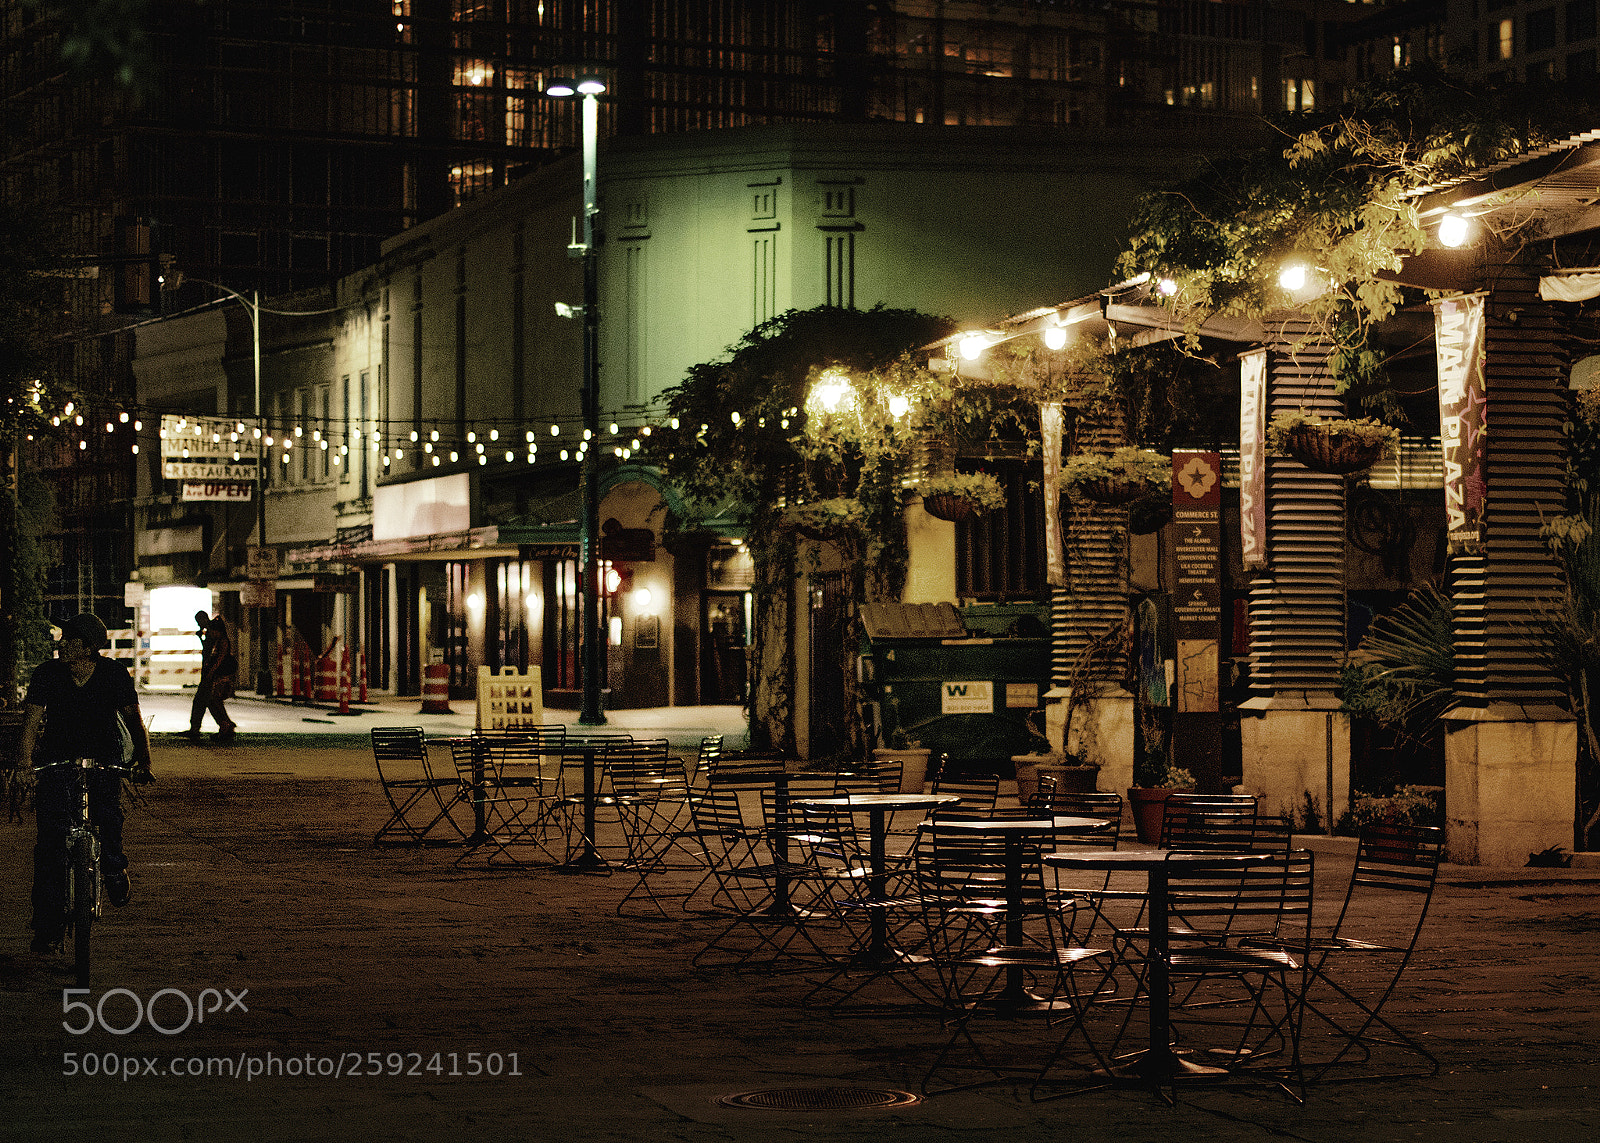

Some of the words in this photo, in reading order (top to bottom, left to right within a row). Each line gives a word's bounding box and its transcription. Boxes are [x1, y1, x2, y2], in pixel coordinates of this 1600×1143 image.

[1439, 311, 1466, 406] MAIN
[205, 482, 251, 498] OPEN
[1175, 511, 1209, 519] COMMERCE
[1210, 511, 1219, 519] ST.
[1241, 454, 1256, 554] PLAZA
[1442, 415, 1466, 532] PLAZA
